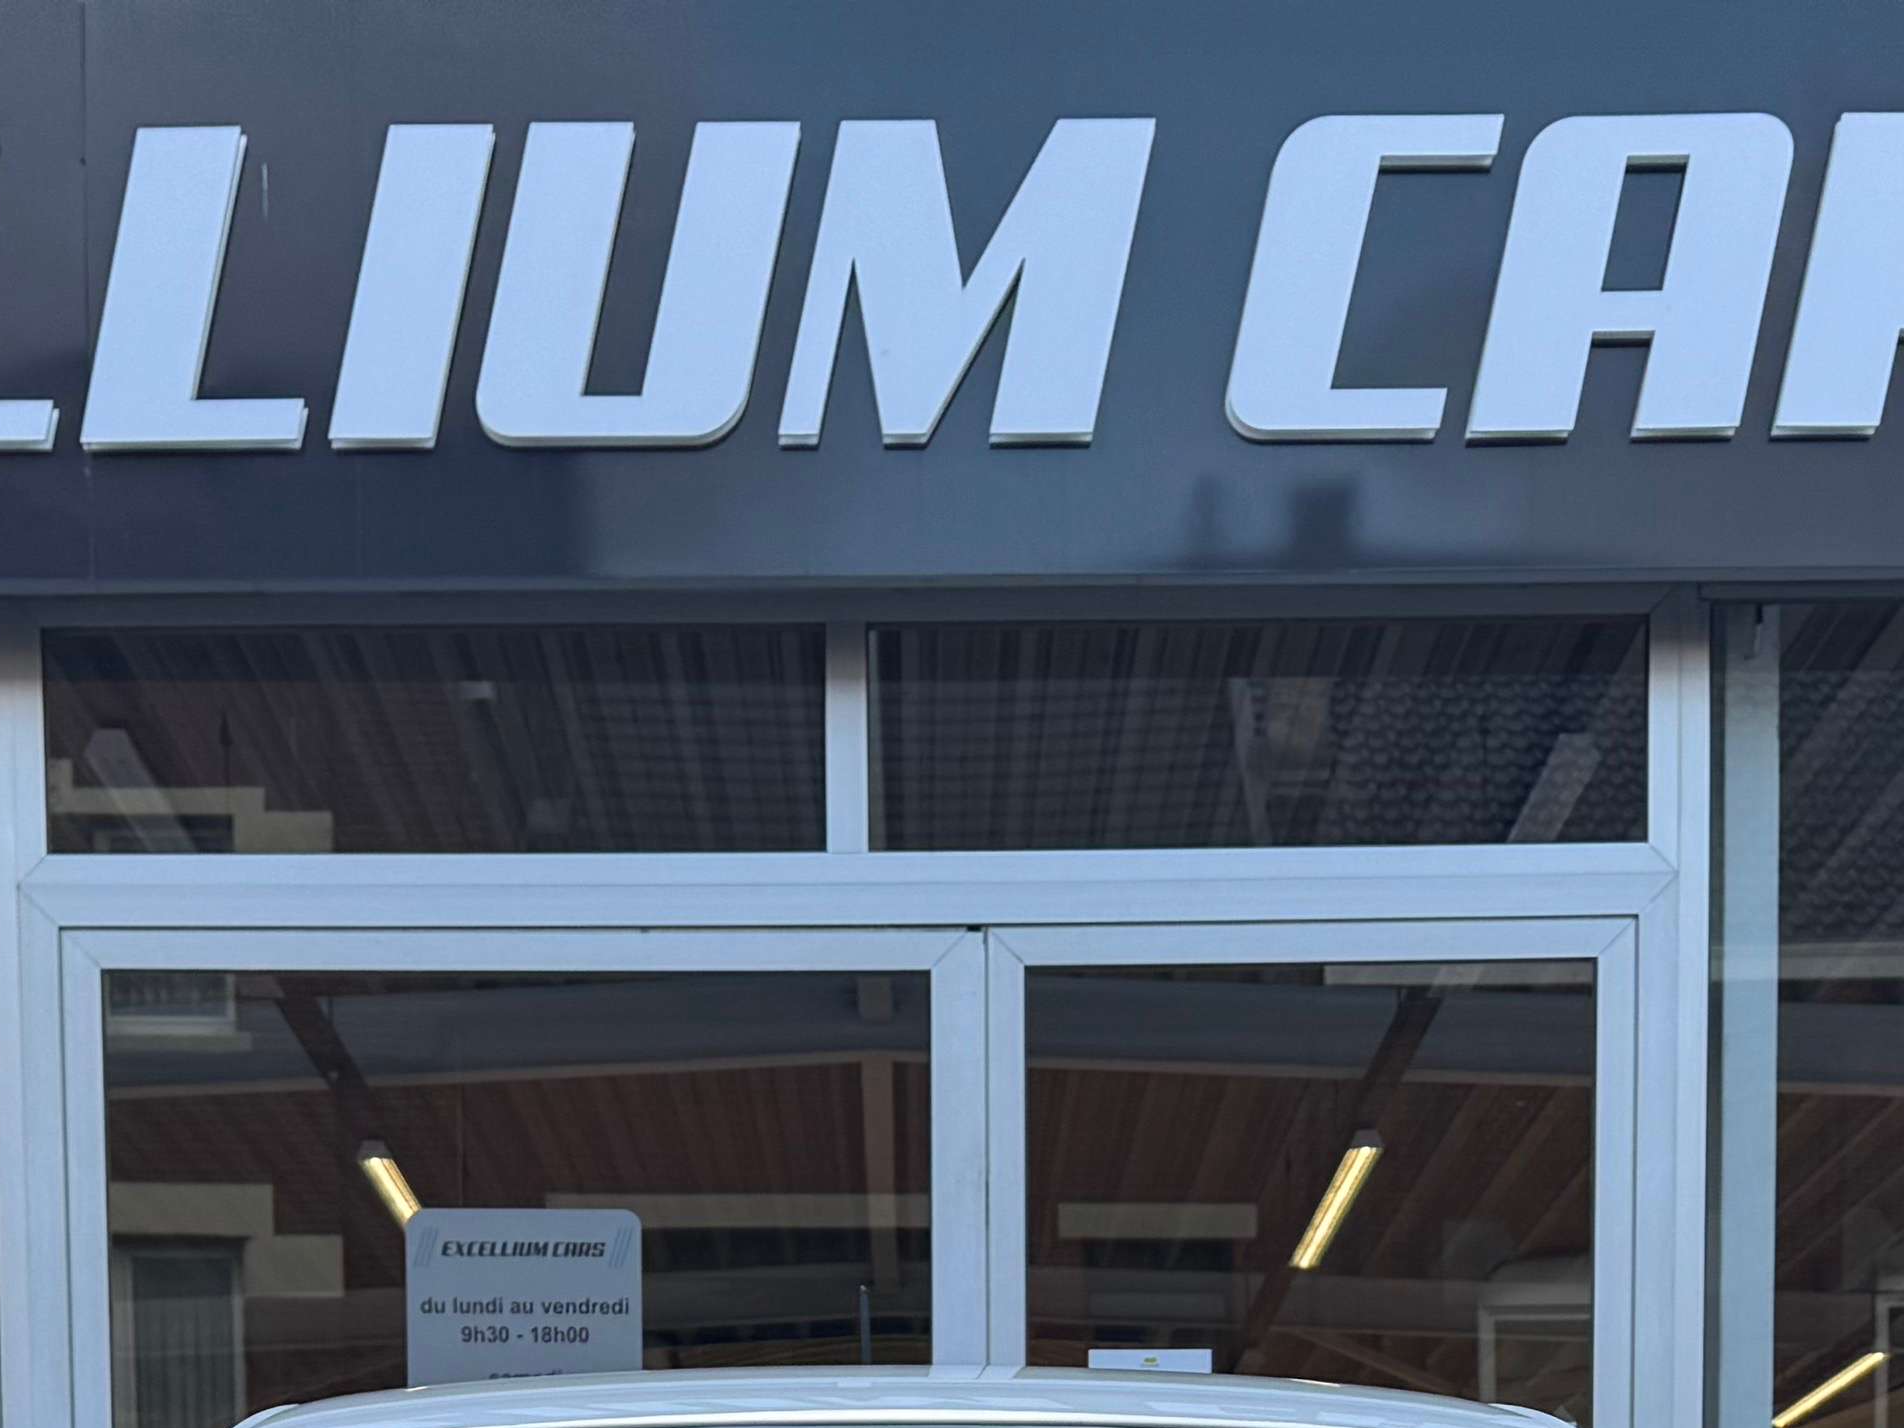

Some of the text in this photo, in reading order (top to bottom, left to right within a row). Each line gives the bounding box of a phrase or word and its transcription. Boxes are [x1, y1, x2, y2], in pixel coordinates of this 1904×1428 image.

[441, 1240, 606, 1258] EXCELLIUM CARS
[420, 1297, 630, 1315] du lundi au vendredi
[460, 1325, 510, 1344] 9h30
[530, 1325, 590, 1344] 18h00
